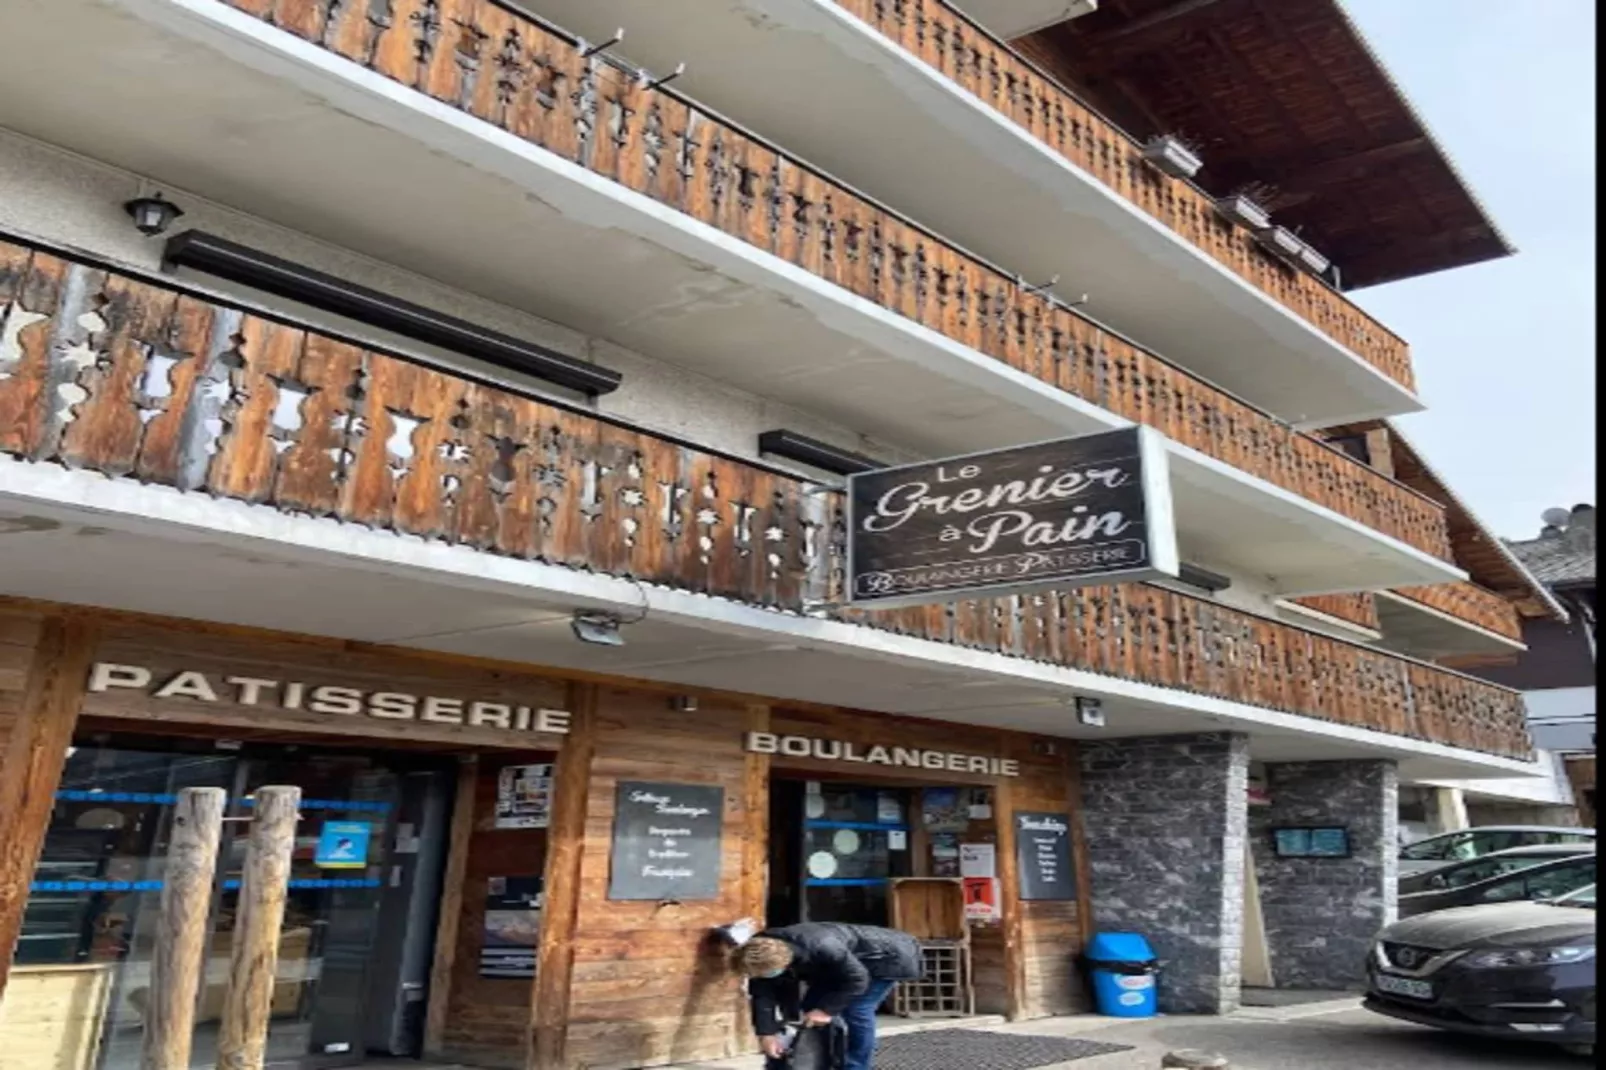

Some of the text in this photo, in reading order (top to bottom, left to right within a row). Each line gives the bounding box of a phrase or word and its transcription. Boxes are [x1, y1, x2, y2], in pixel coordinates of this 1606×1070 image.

[937, 464, 982, 483] Le
[863, 464, 1129, 532] Grenier
[939, 505, 1132, 552] à Pain
[89, 662, 572, 735] PATISSERIE
[748, 731, 1020, 777] BOULANGERIE
